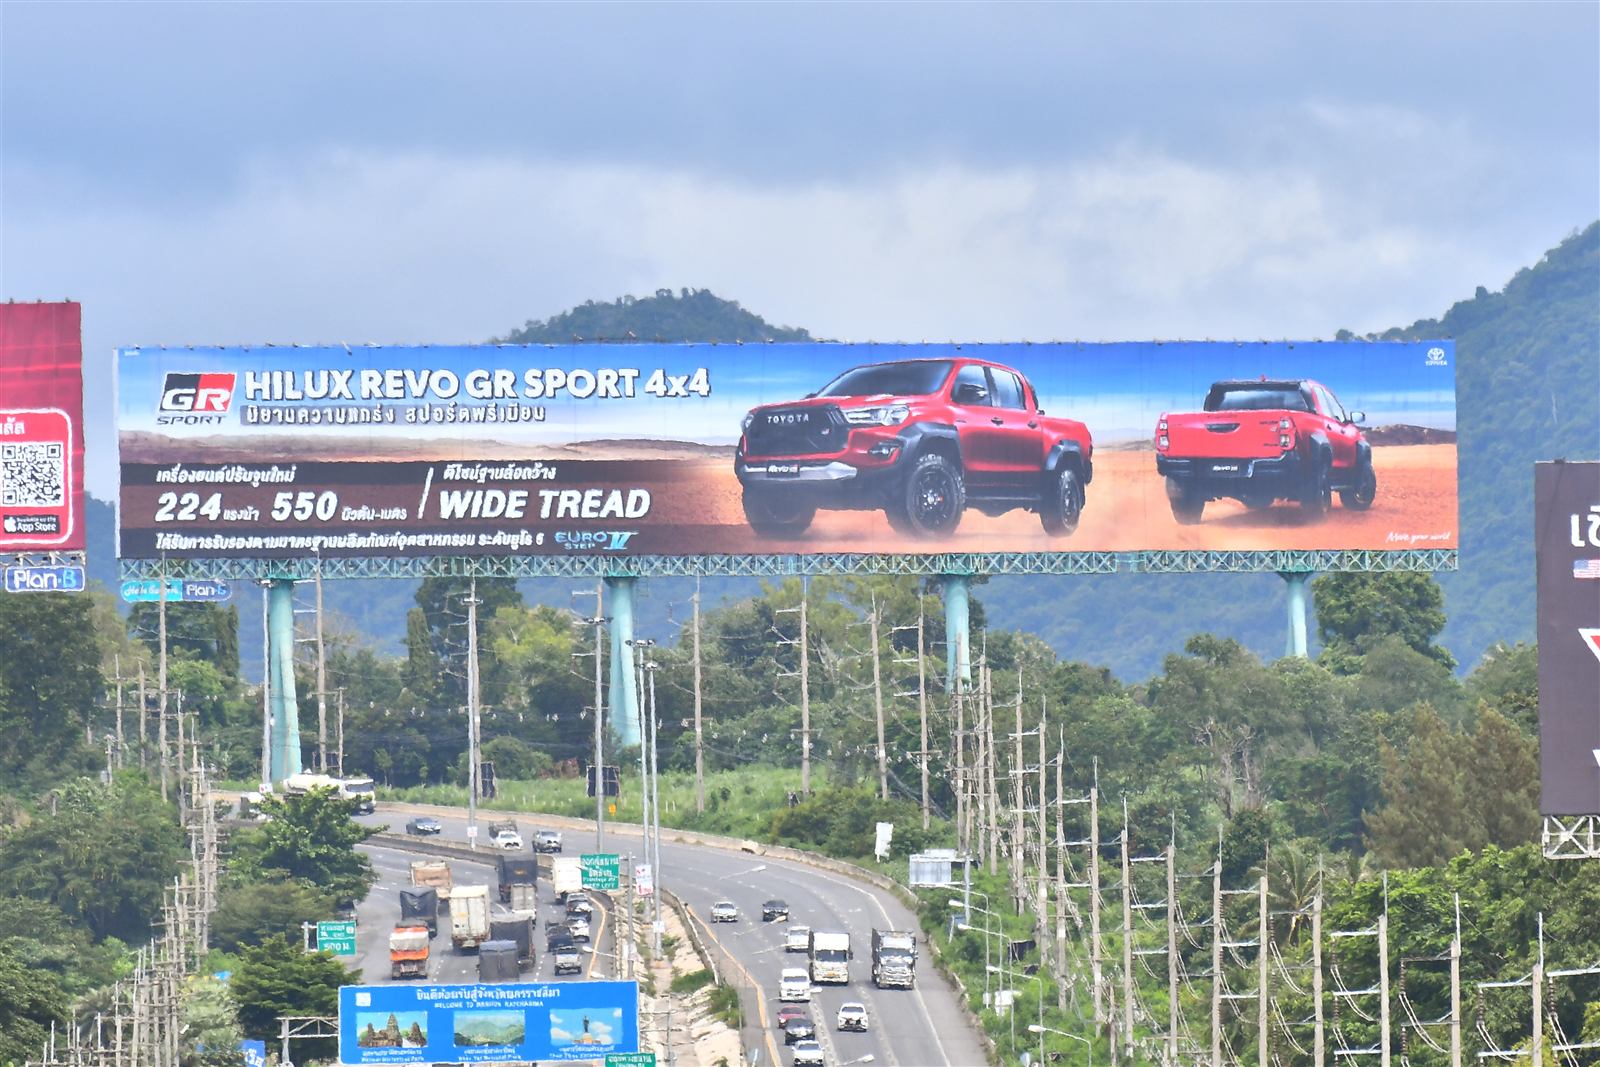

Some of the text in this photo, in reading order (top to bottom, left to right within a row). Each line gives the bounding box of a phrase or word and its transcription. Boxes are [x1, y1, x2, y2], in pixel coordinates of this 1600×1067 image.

[245, 367, 711, 400] HILUX REVO GR SPORT 4x4
[161, 388, 232, 412] GR
[157, 415, 226, 426] SPORT
[767, 413, 809, 424] TOYOTA
[155, 491, 223, 523] 224
[271, 490, 338, 522] 550
[439, 488, 651, 520] WIDE TREAD
[17, 521, 57, 533] App Store
[554, 530, 608, 543] EURO
